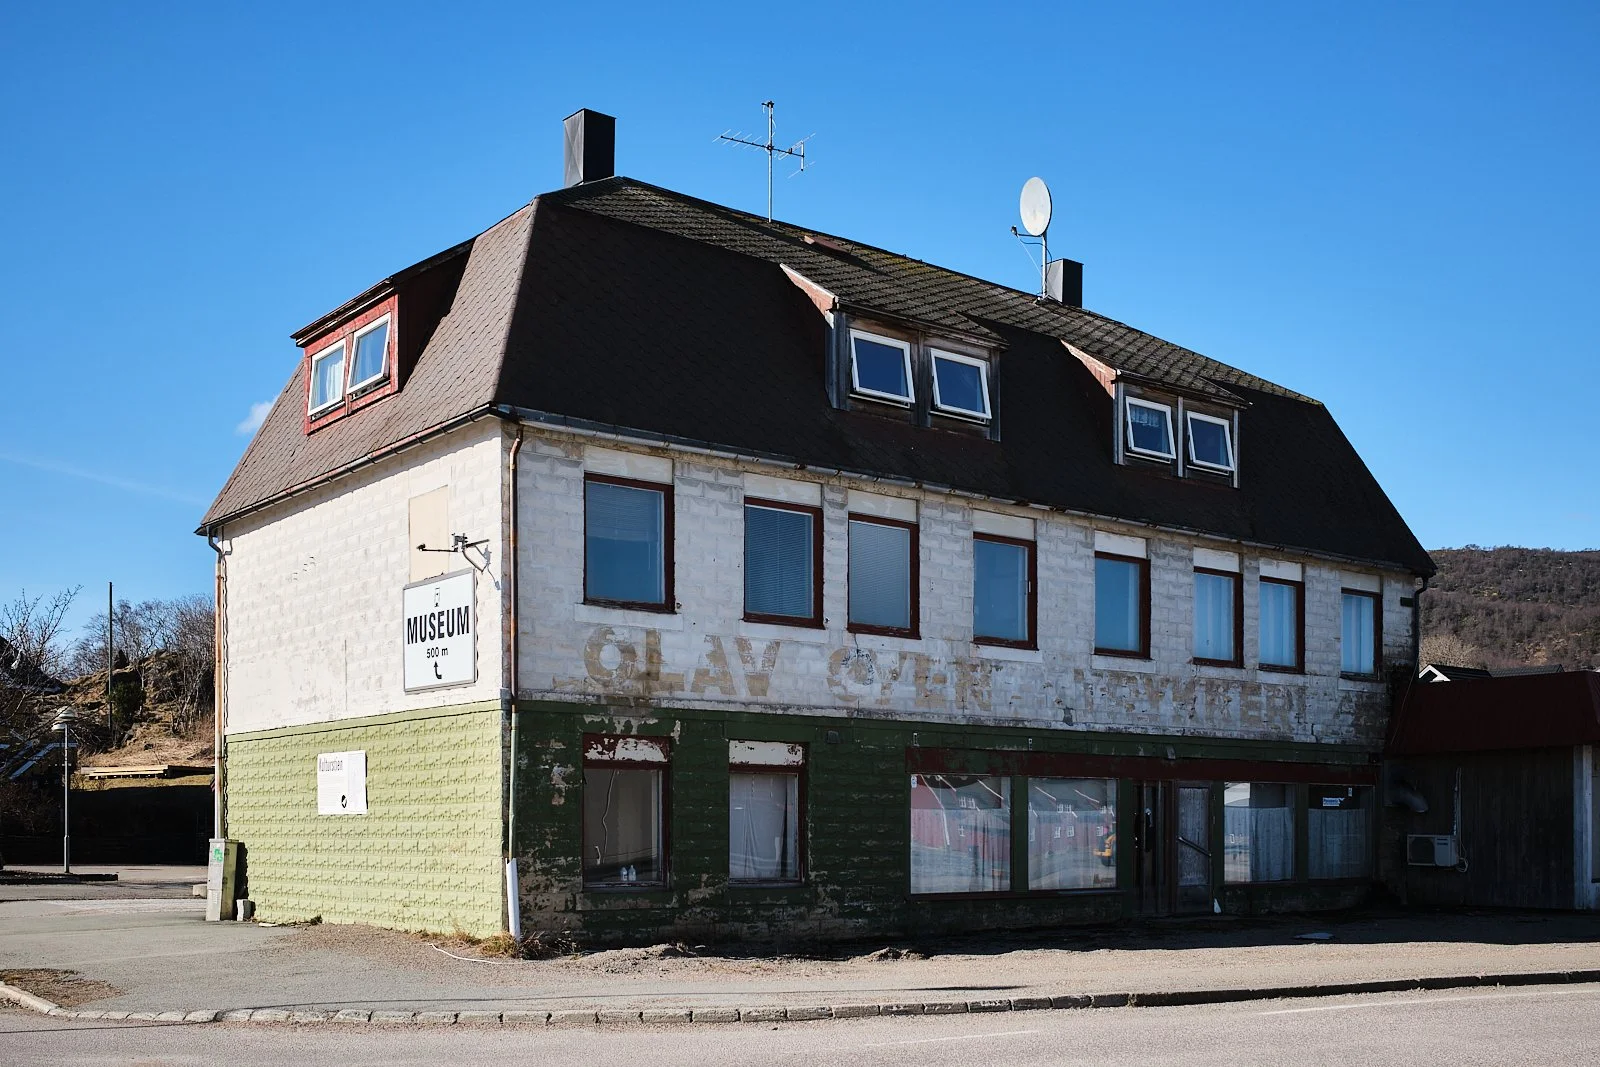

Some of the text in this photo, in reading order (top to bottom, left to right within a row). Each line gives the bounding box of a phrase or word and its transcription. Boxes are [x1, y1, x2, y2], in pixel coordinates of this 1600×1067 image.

[407, 606, 470, 645] MUSEUM
[426, 647, 449, 659] 500 m
[584, 626, 780, 697] OLAV
